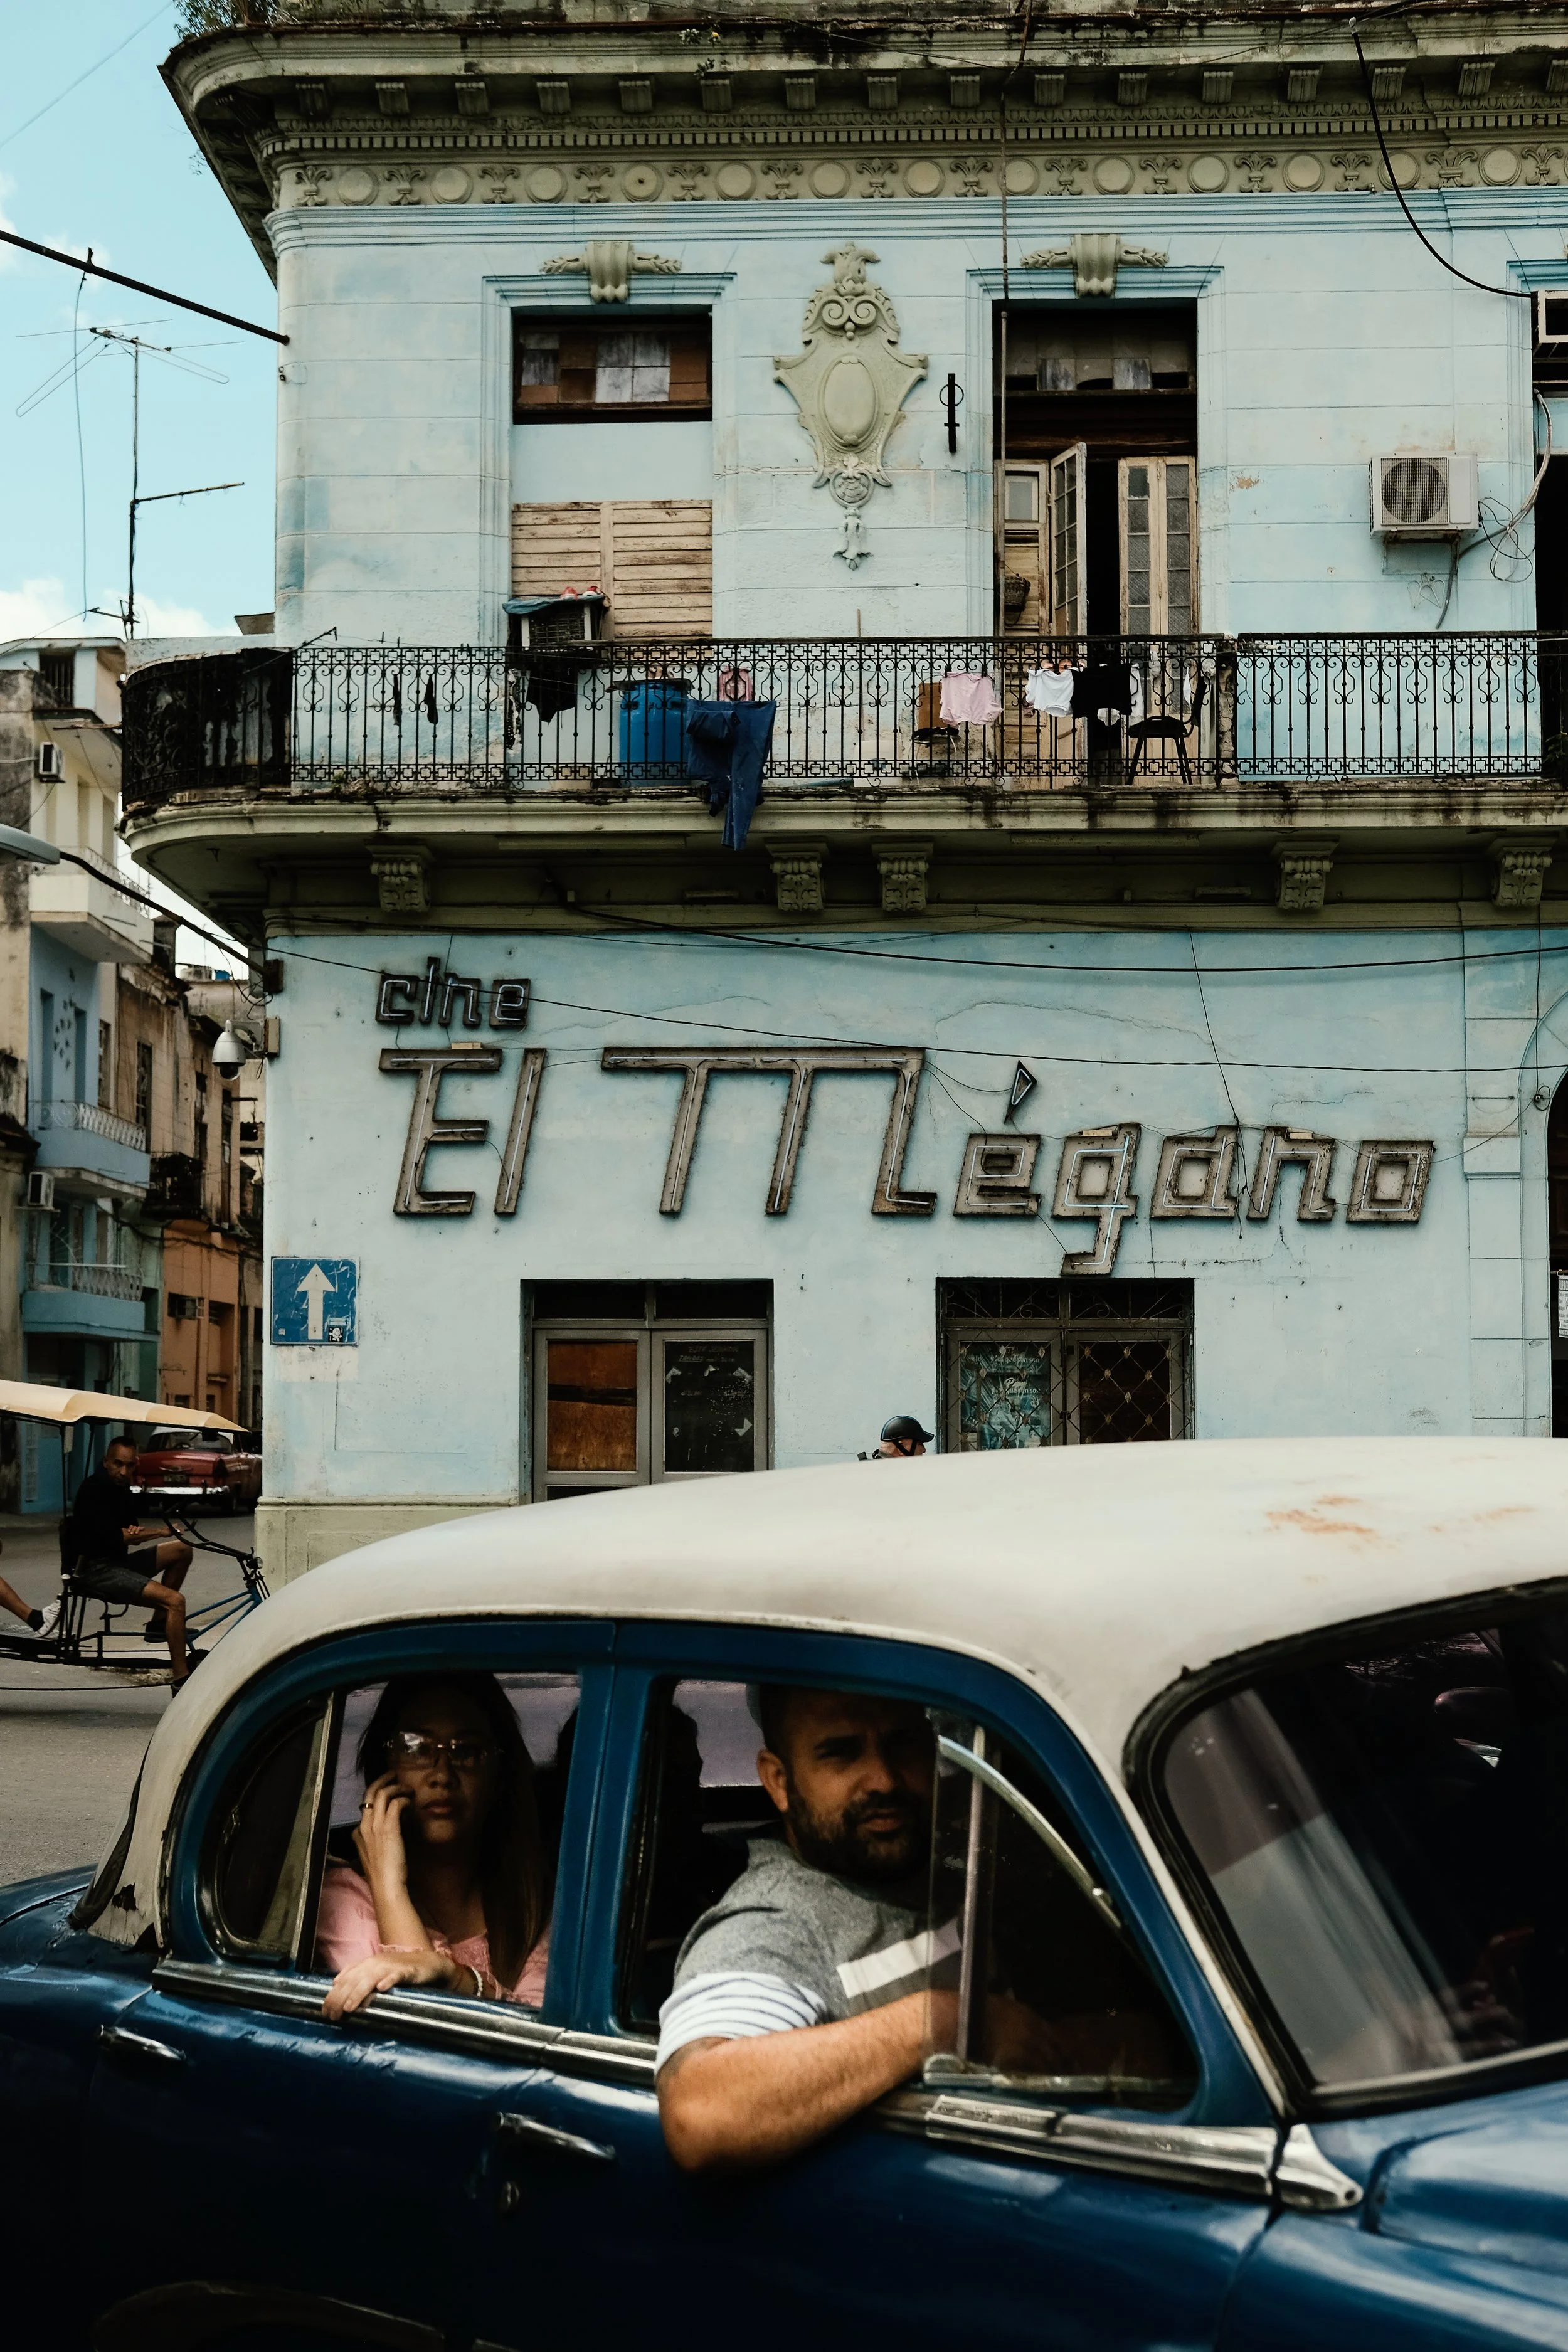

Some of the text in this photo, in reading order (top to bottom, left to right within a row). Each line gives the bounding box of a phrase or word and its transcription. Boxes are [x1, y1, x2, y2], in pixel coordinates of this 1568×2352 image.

[375, 956, 531, 1027] cine
[378, 1047, 1434, 1276] El Mégano
